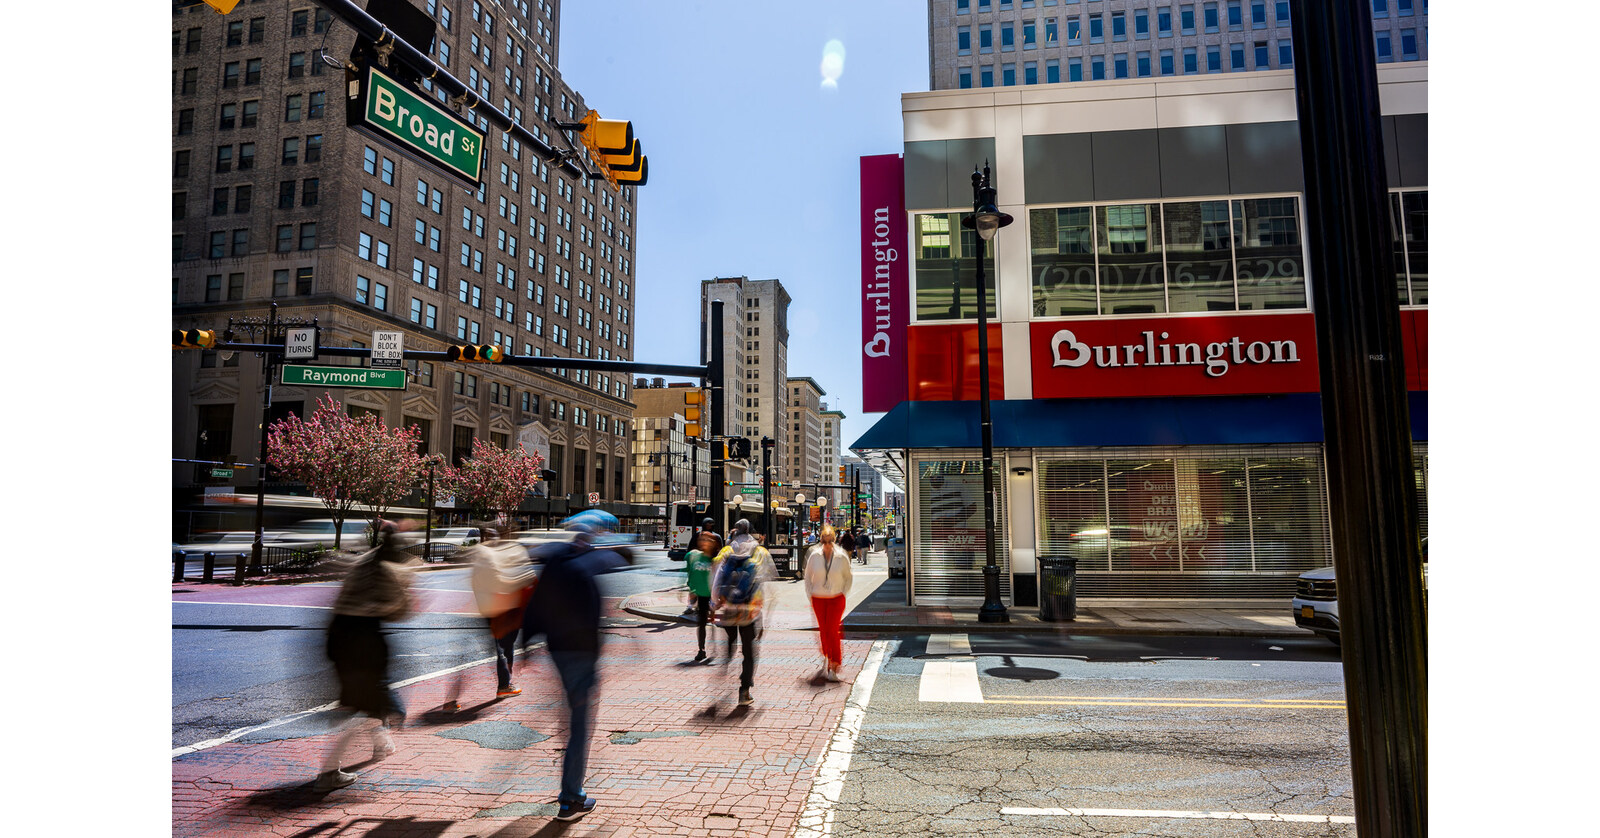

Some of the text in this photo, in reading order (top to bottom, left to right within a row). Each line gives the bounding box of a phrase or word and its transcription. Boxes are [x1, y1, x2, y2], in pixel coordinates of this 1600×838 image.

[374, 84, 475, 157] Broad St
[863, 206, 898, 358] Burlington
[294, 333, 307, 342] NO
[379, 333, 397, 341] DON'T
[288, 345, 312, 354] TURNS
[377, 341, 398, 350] BLOCK
[373, 350, 401, 359] THE BOX
[1051, 329, 1301, 377] Burlington
[303, 369, 367, 383] Raymond
[1145, 520, 1206, 537] WOW!
[946, 534, 976, 545] SAVE
